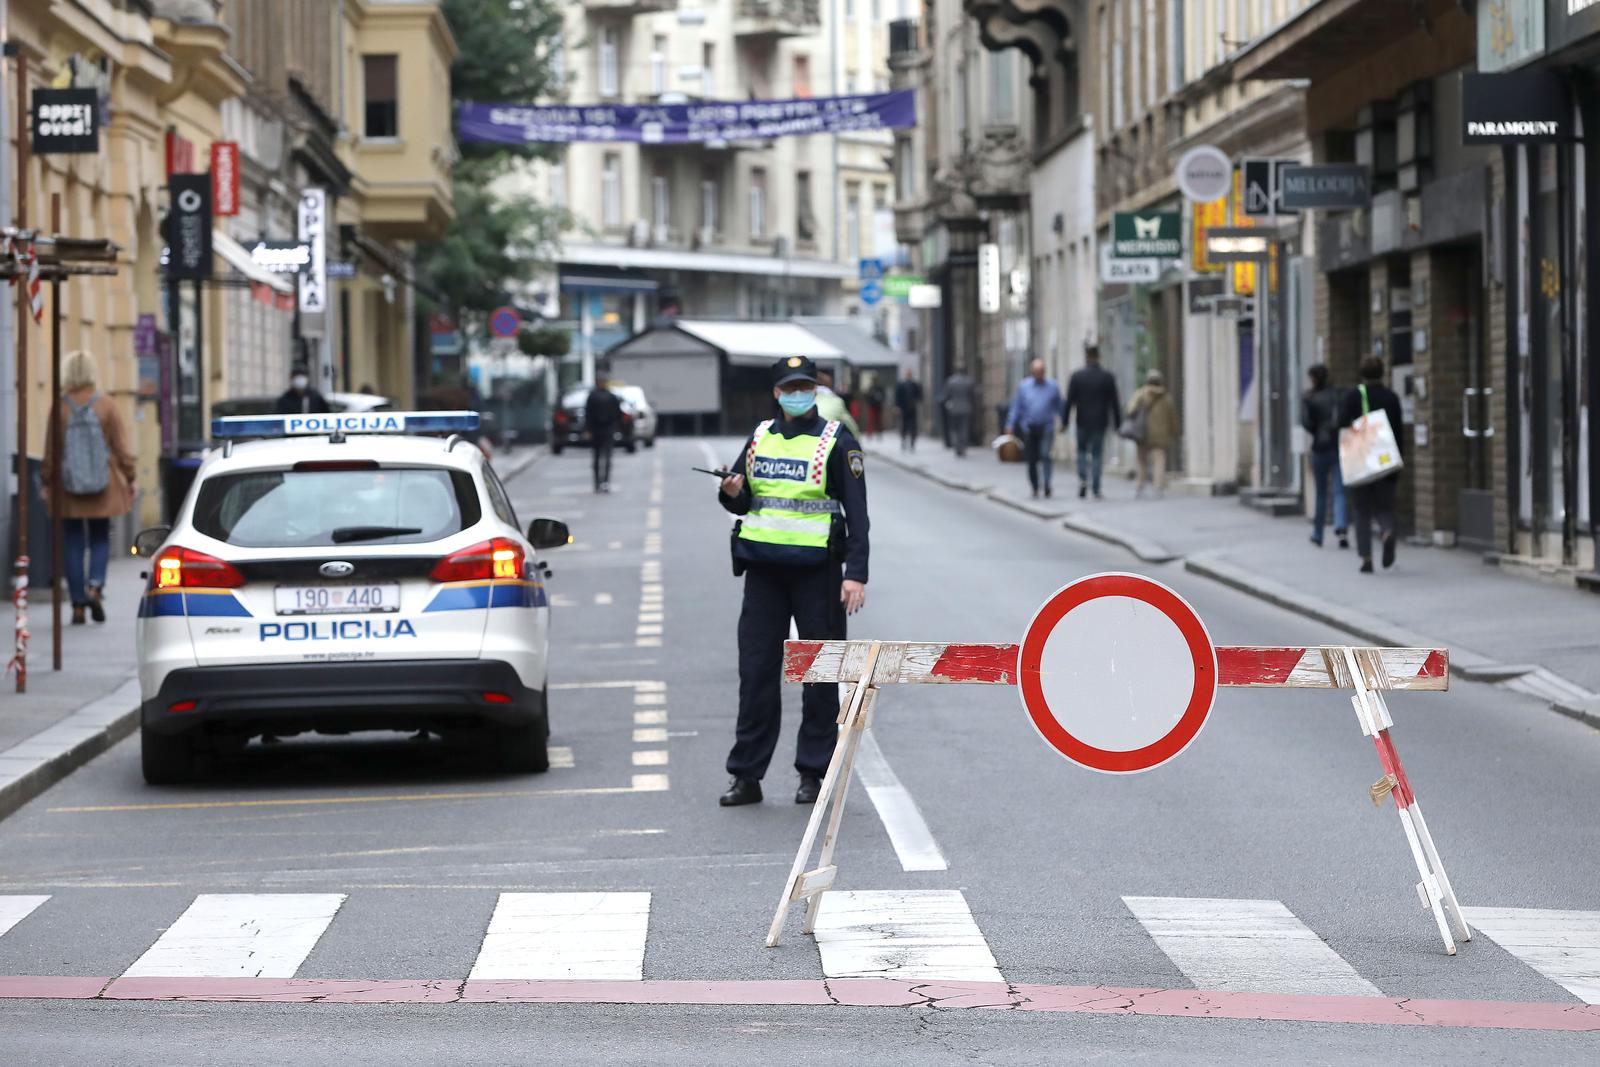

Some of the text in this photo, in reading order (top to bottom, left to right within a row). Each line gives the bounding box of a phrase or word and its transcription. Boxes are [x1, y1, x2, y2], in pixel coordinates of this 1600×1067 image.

[1468, 121, 1558, 135] PARAMOUNT
[290, 416, 399, 431] POLICIJA
[754, 461, 805, 477] POLICIJA
[295, 586, 382, 608] 190 440
[259, 619, 417, 641] POLICIJA
